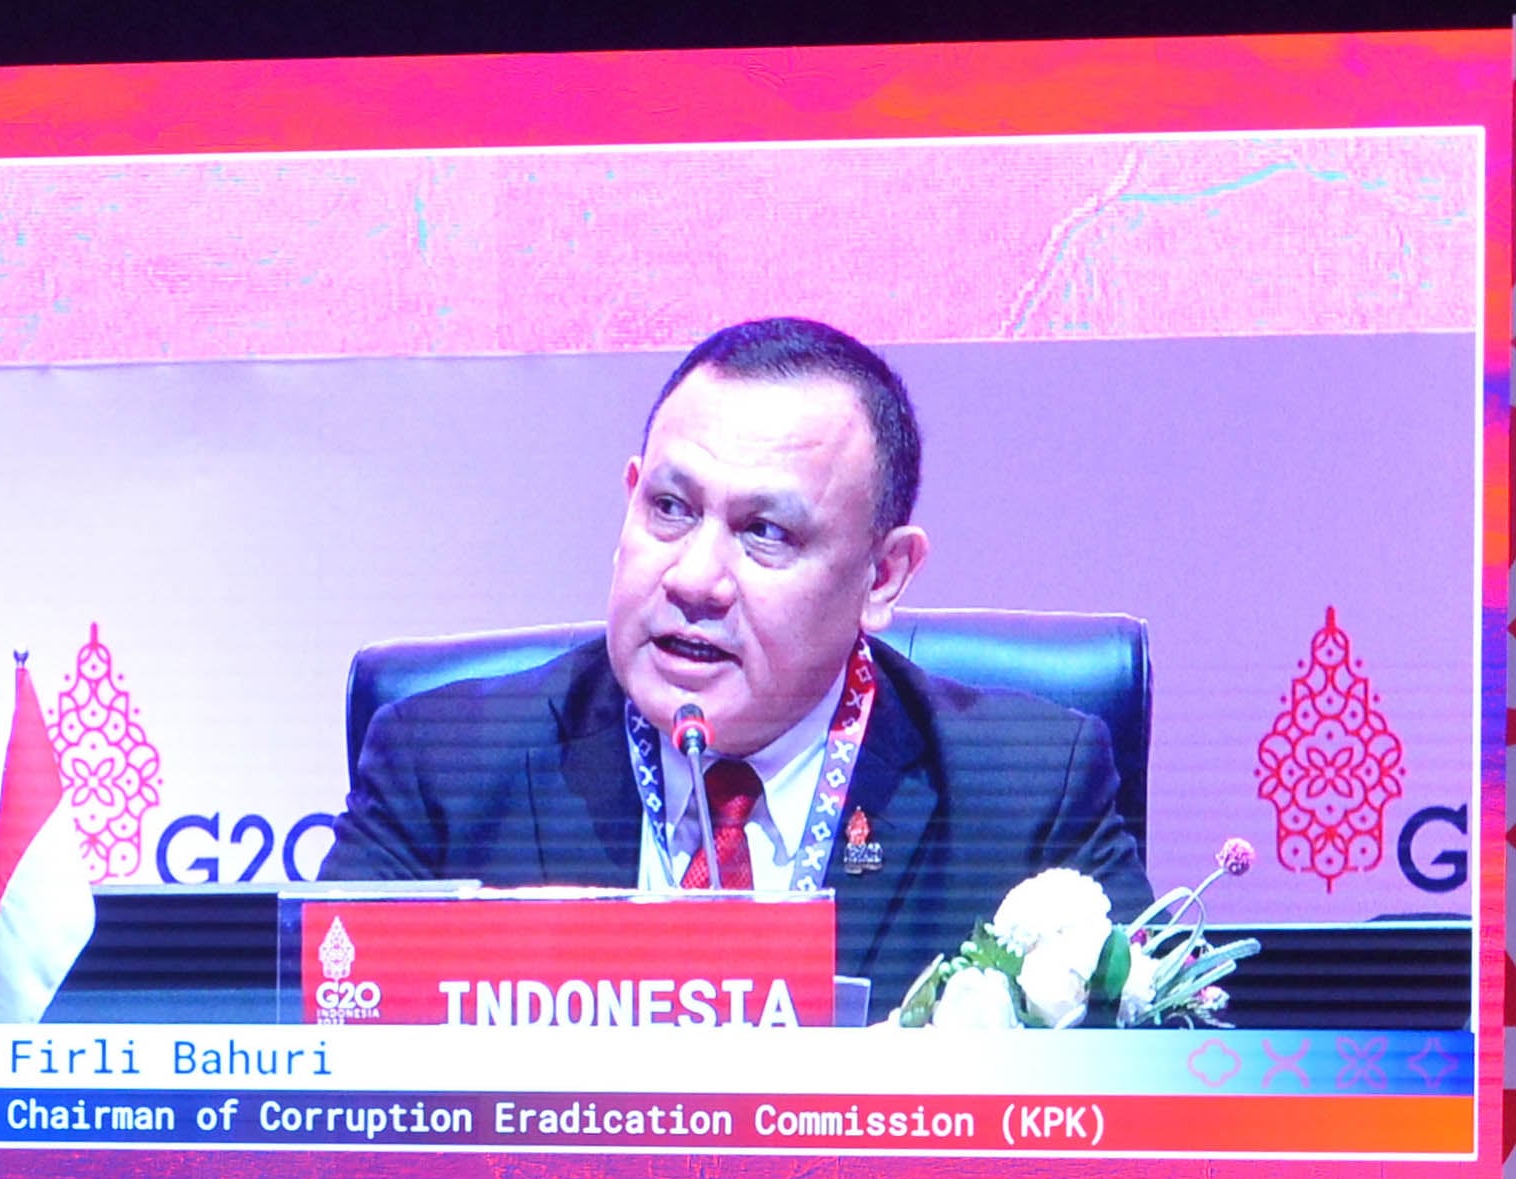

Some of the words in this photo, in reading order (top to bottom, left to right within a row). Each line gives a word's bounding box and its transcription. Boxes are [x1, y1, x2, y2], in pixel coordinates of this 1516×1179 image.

[316, 981, 381, 1009] G20
[438, 979, 801, 1027] INDONESIA
[10, 1039, 140, 1075] Firli
[173, 1040, 333, 1076] Bahuri
[6, 1098, 175, 1131] Chairman
[197, 1099, 239, 1131] of
[259, 1101, 473, 1139] Corruption
[494, 1102, 732, 1137] Eradication
[754, 1104, 975, 1139] Commission
[1001, 1104, 1106, 1145] (KPK)
